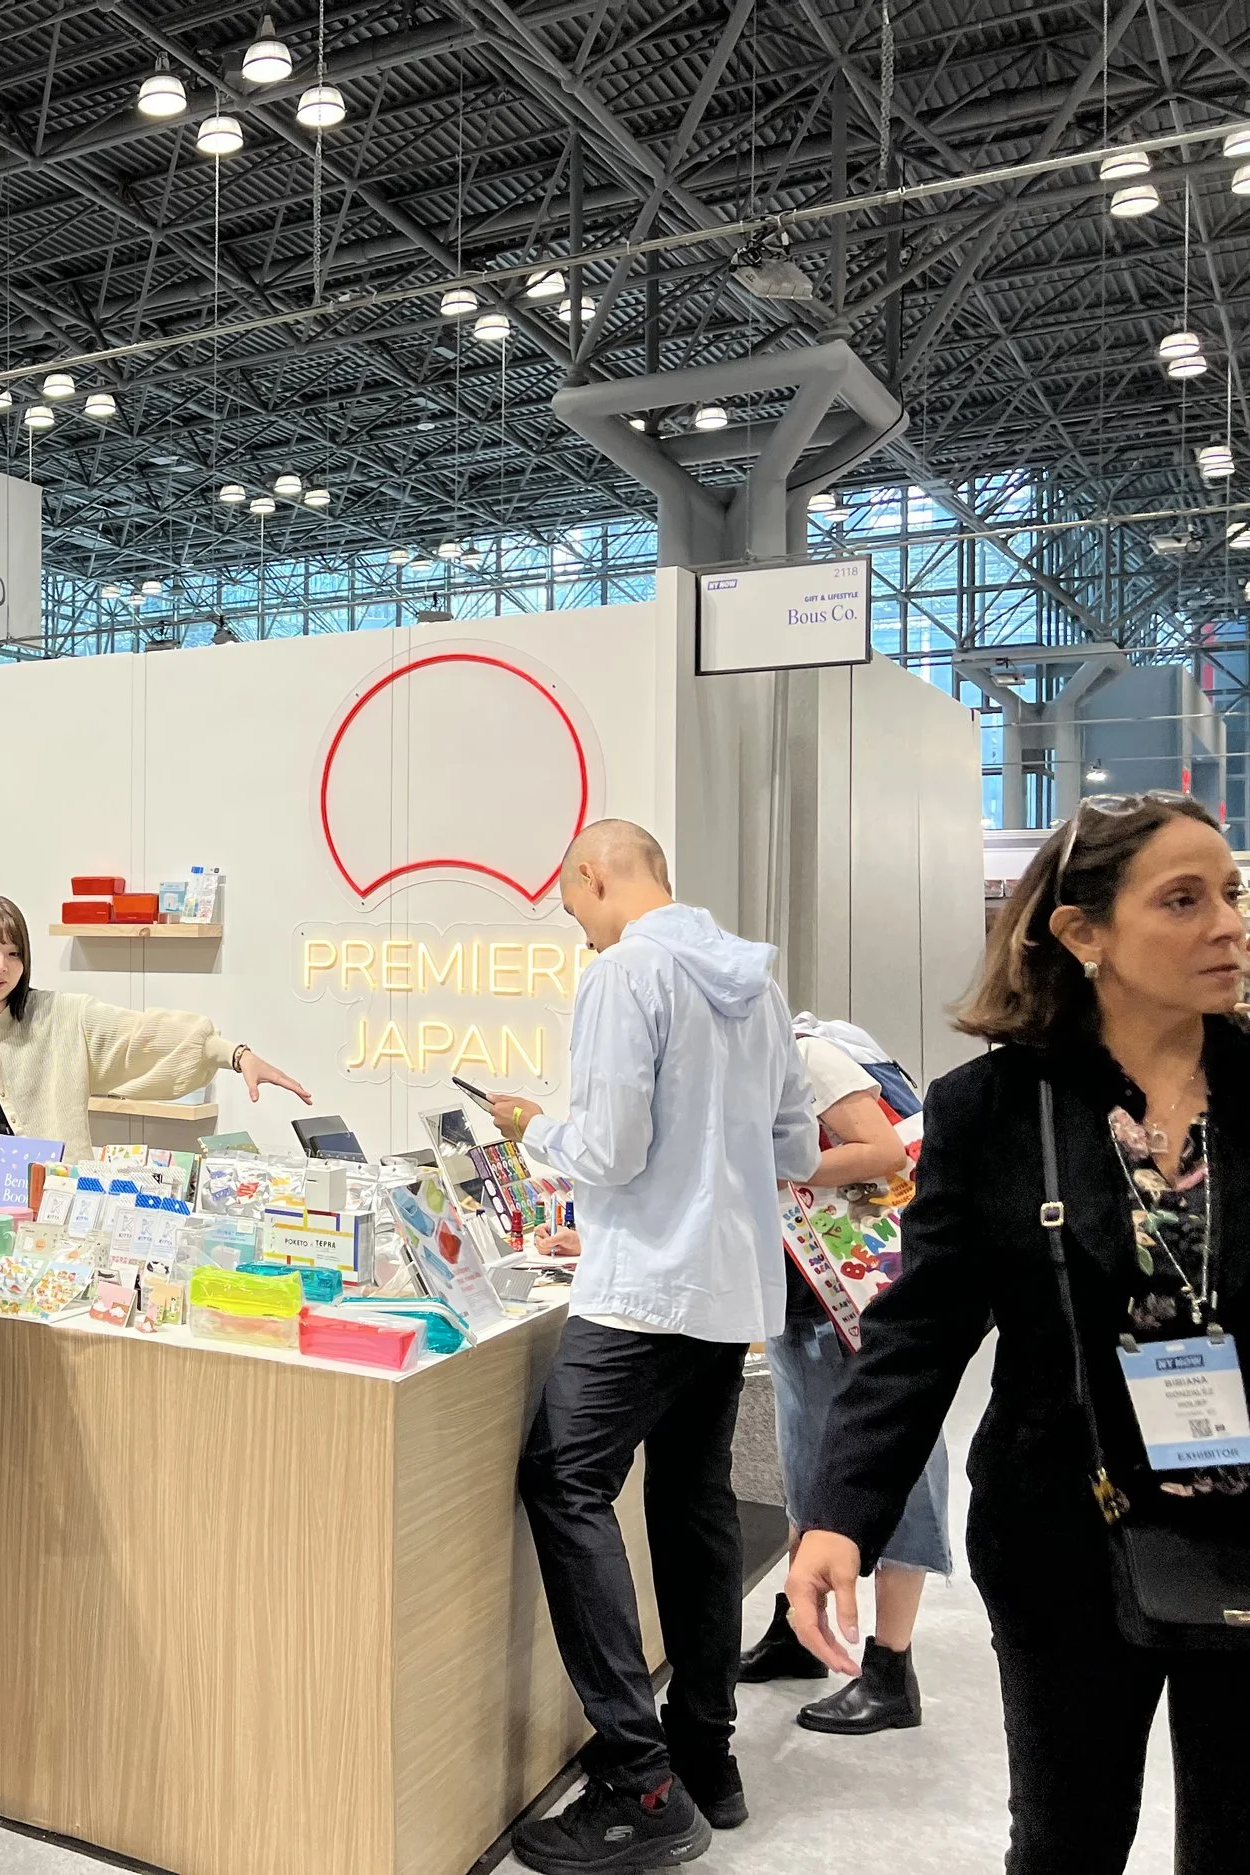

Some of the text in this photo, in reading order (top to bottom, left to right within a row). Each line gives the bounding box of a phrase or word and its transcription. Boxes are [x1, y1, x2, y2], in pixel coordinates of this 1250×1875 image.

[834, 567, 858, 577] 2118
[720, 579, 737, 589] NOW
[828, 591, 858, 600] LIFESTYLE
[788, 604, 858, 625] Bous Co.
[346, 1017, 544, 1077] JAPAN
[285, 1238, 308, 1247] POKETO
[315, 1240, 336, 1248] TEPRA
[1177, 1448, 1239, 1461] EXHIBITOR
